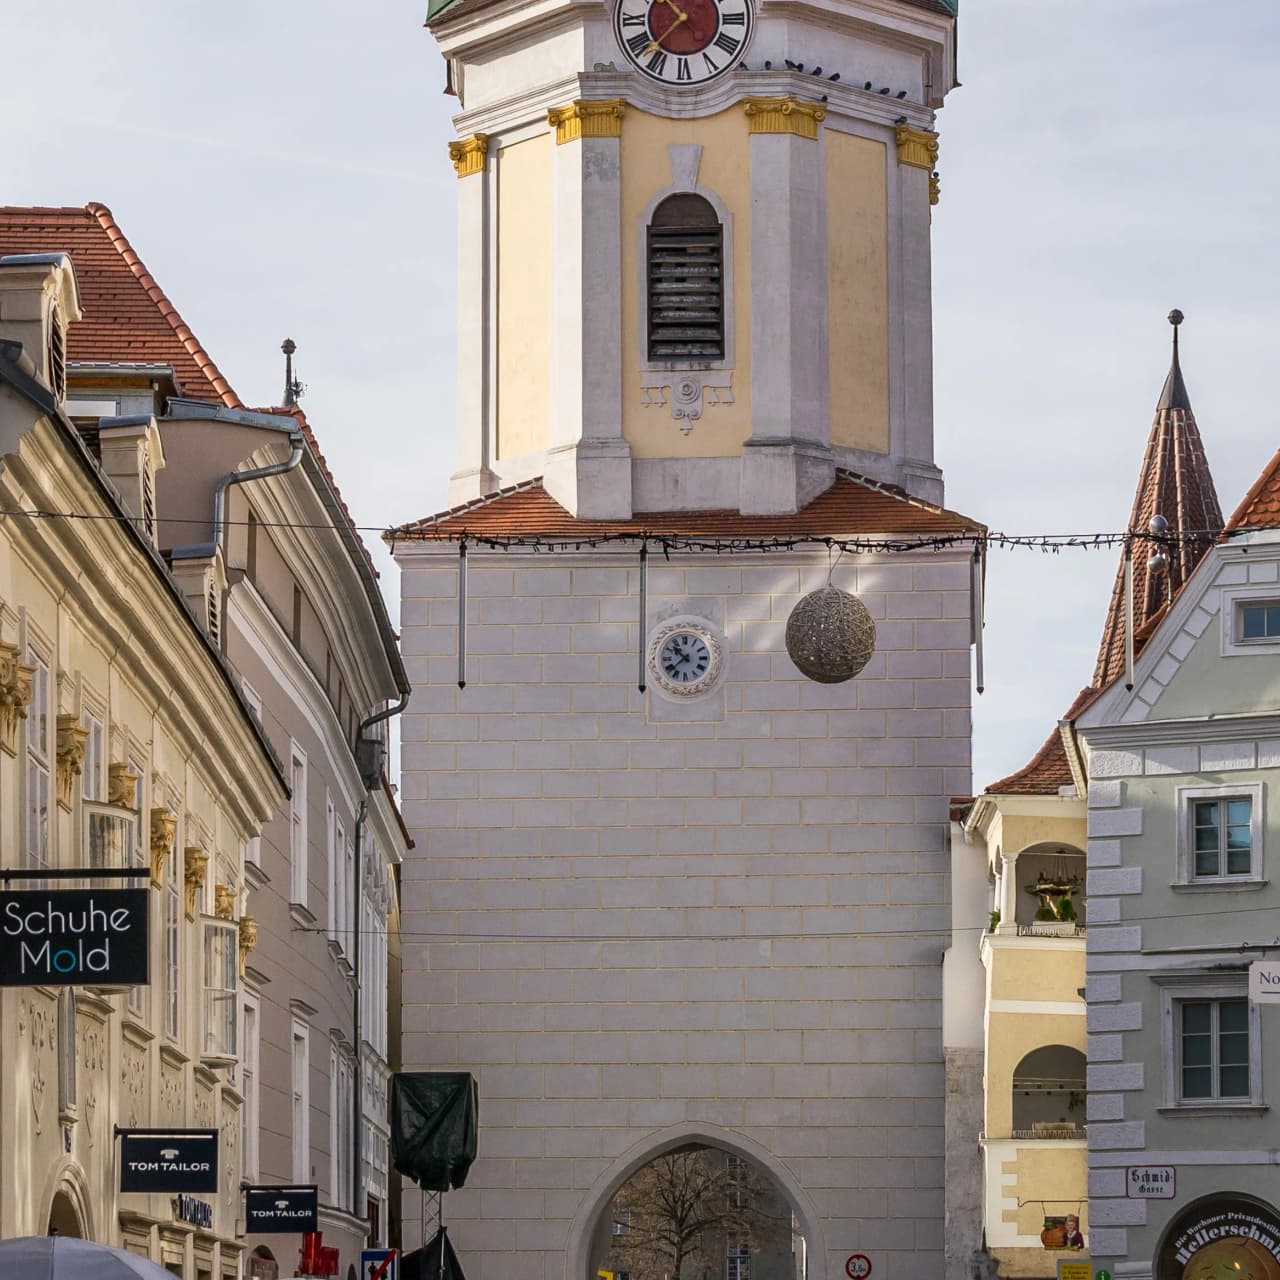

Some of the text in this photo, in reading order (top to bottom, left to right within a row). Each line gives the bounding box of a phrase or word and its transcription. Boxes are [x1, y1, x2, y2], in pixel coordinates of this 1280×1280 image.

[623, 12, 646, 27] IX
[722, 12, 745, 26] III
[646, 51, 667, 76] VII
[676, 57, 692, 80] VI
[702, 52, 720, 74] V
[3, 899, 131, 936] Schuhe
[20, 938, 110, 974] Mold
[128, 1162, 210, 1171] TOM TAILOR
[251, 1210, 313, 1218] TOM TAILOR
